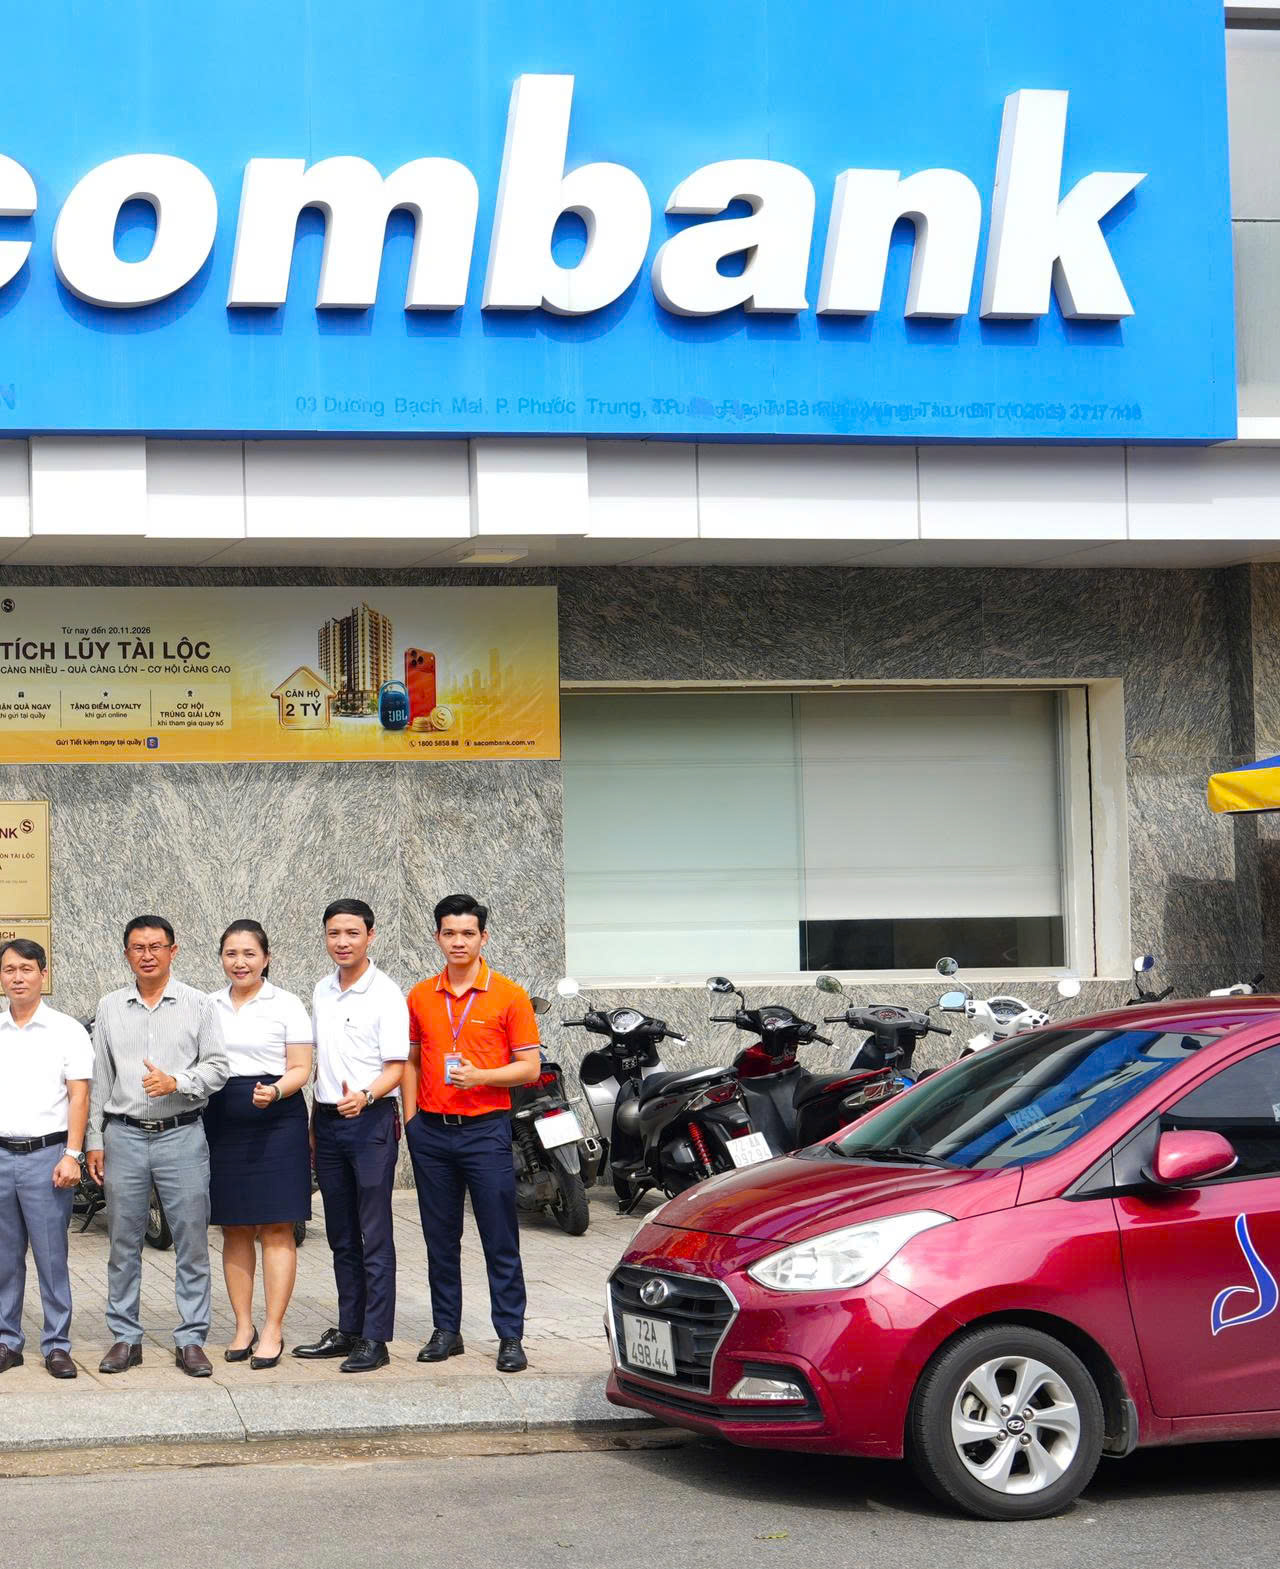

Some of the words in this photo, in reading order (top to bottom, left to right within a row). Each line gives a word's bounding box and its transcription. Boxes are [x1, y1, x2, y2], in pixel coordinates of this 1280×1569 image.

[295, 396, 318, 414] 03
[61, 626, 72, 635] Từ
[74, 628, 89, 637] nay
[90, 626, 106, 635] đến
[108, 626, 151, 635] 20.11.2026
[0, 637, 55, 660] TÍCH
[64, 637, 110, 660] LŨY
[118, 637, 154, 660] TÀI
[163, 636, 211, 662] LỘC
[0, 664, 27, 675] CÀNG
[29, 664, 58, 675] NHIỀU
[67, 664, 87, 675] QUÀ
[89, 664, 116, 675] CÀNG
[118, 664, 138, 675] LỚN
[147, 664, 162, 675] CƠ
[164, 664, 181, 675] HỘI
[183, 664, 209, 675] CÀNG
[211, 664, 231, 675] CAO
[306, 688, 320, 699] HỘ
[285, 703, 295, 716] 2
[301, 700, 322, 717] TỶ
[388, 710, 408, 723] JBL
[187, 720, 197, 728] gia
[198, 721, 215, 729] quay
[100, 740, 116, 748] ngay
[418, 739, 433, 747] 1800
[473, 739, 536, 747] sacombank.com.vn
[635, 1318, 657, 1344] 72A
[631, 1342, 669, 1370] 498.44
